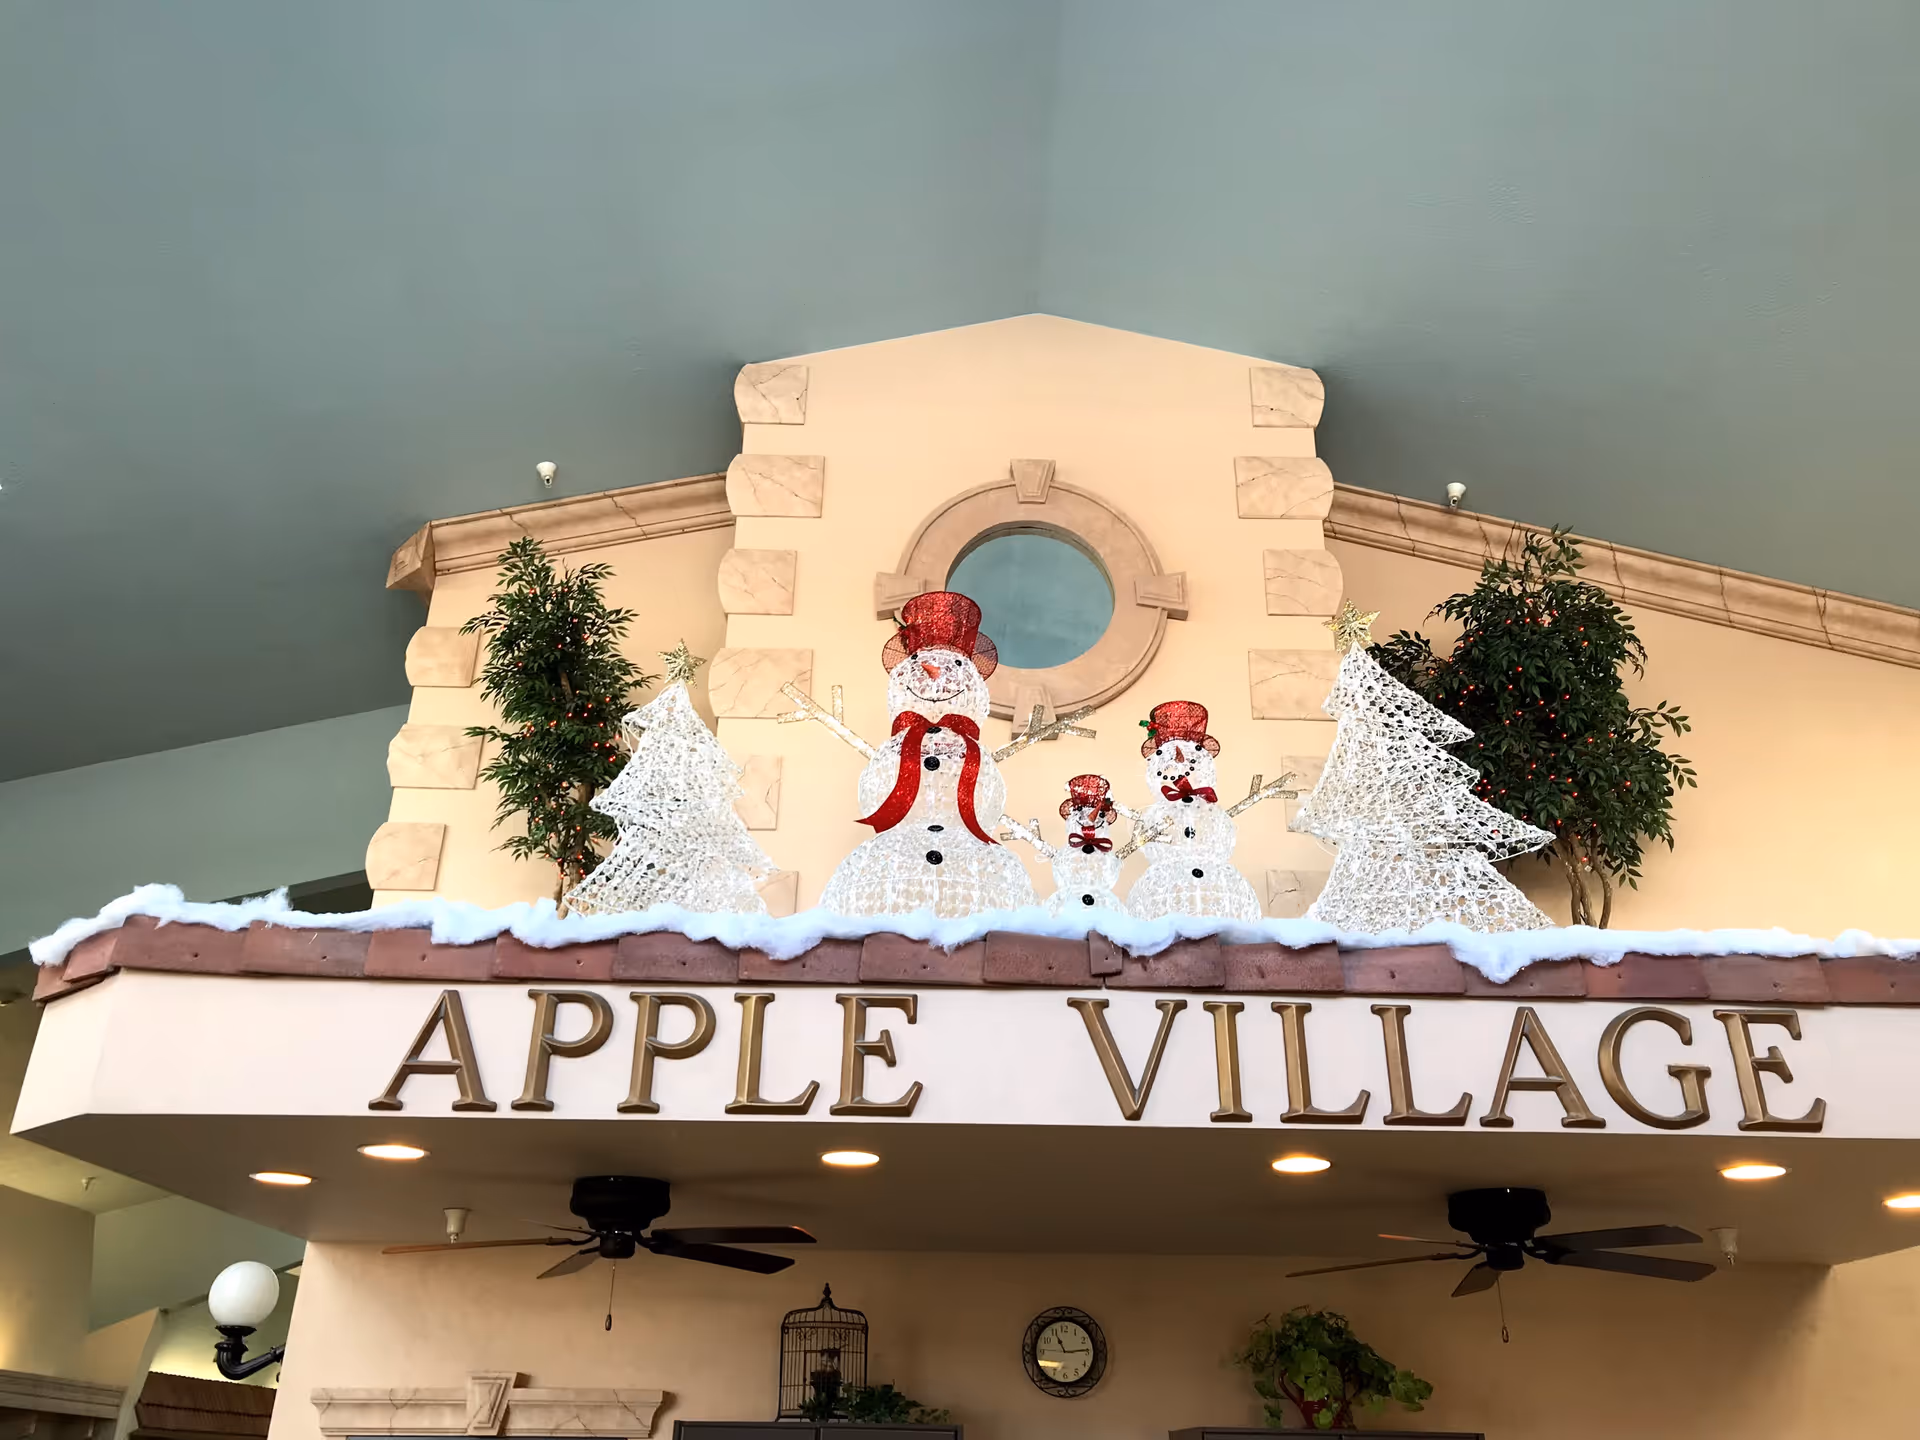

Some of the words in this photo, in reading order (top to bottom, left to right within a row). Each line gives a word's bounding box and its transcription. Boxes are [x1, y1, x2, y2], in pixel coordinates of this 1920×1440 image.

[368, 988, 923, 1117] APPLE
[1067, 997, 1826, 1133] VILLAGE
[1051, 1328, 1058, 1336] 11
[1060, 1325, 1069, 1333] 12
[1043, 1336, 1051, 1344] 10
[1073, 1368, 1079, 1376] 5
